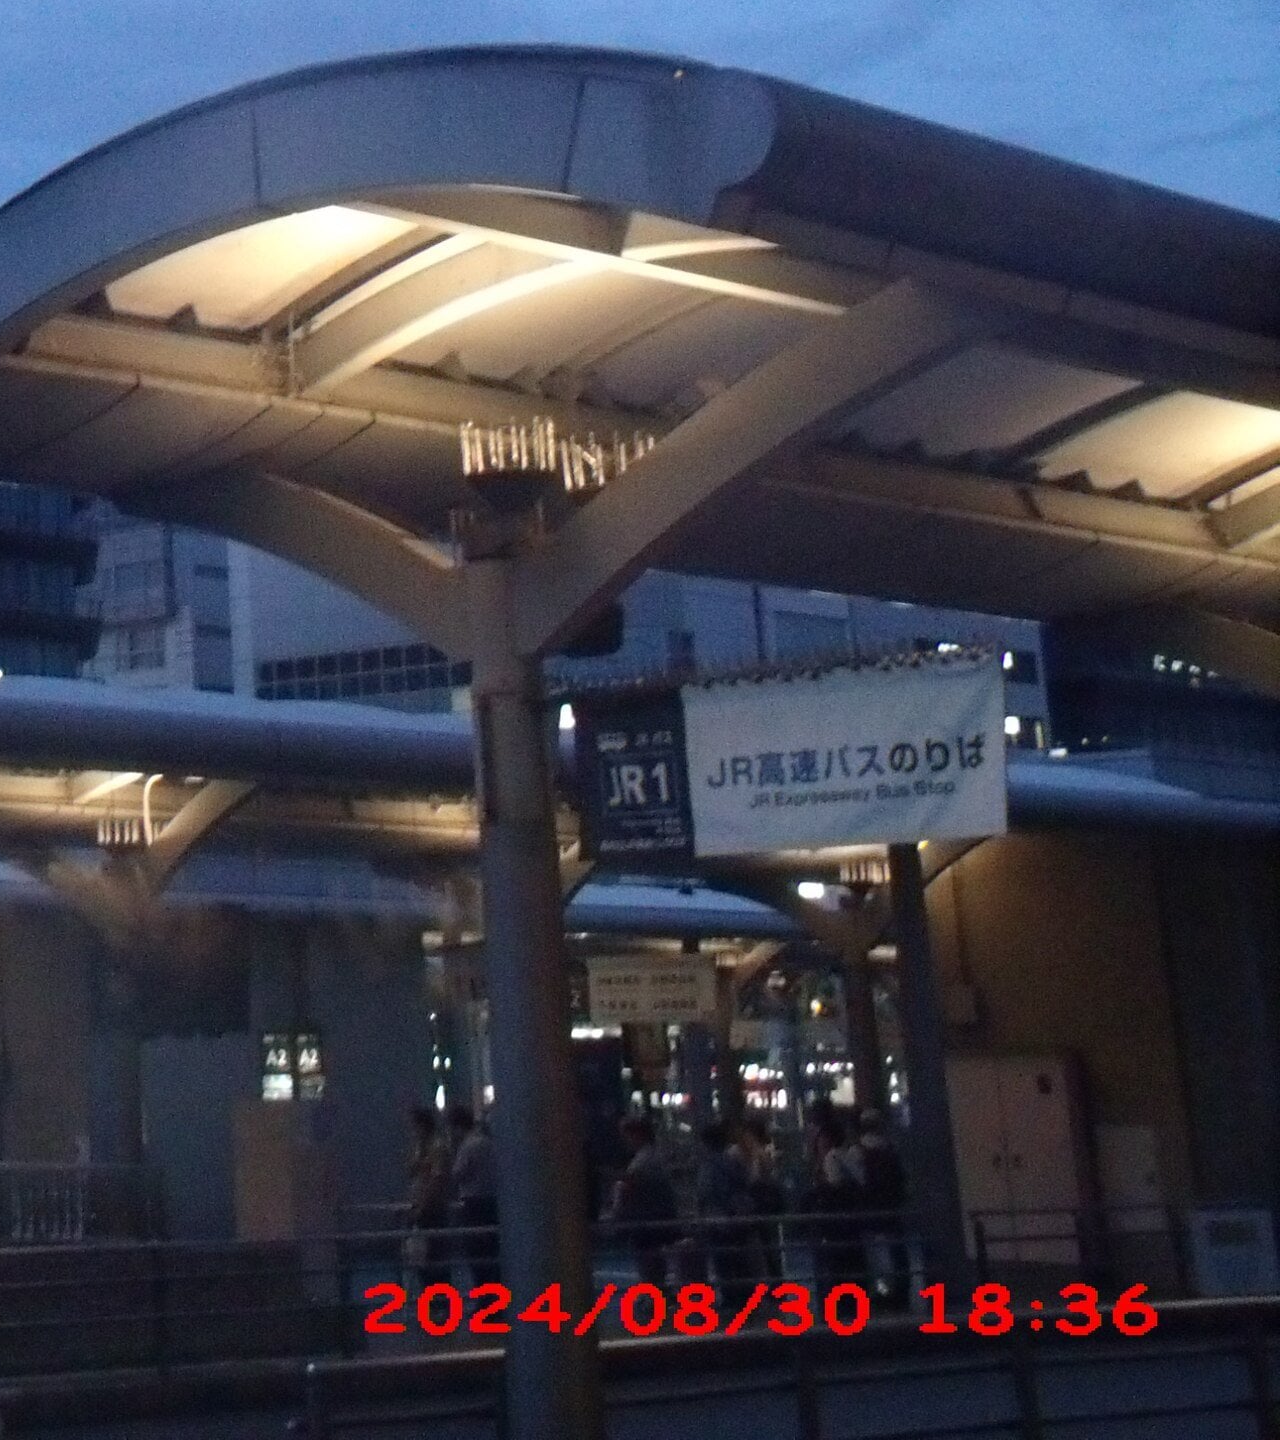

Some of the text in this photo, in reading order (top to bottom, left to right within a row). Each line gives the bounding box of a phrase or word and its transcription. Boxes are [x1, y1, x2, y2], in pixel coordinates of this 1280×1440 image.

[707, 732, 986, 789] JR高速バスのりば
[266, 1048, 287, 1067] A2
